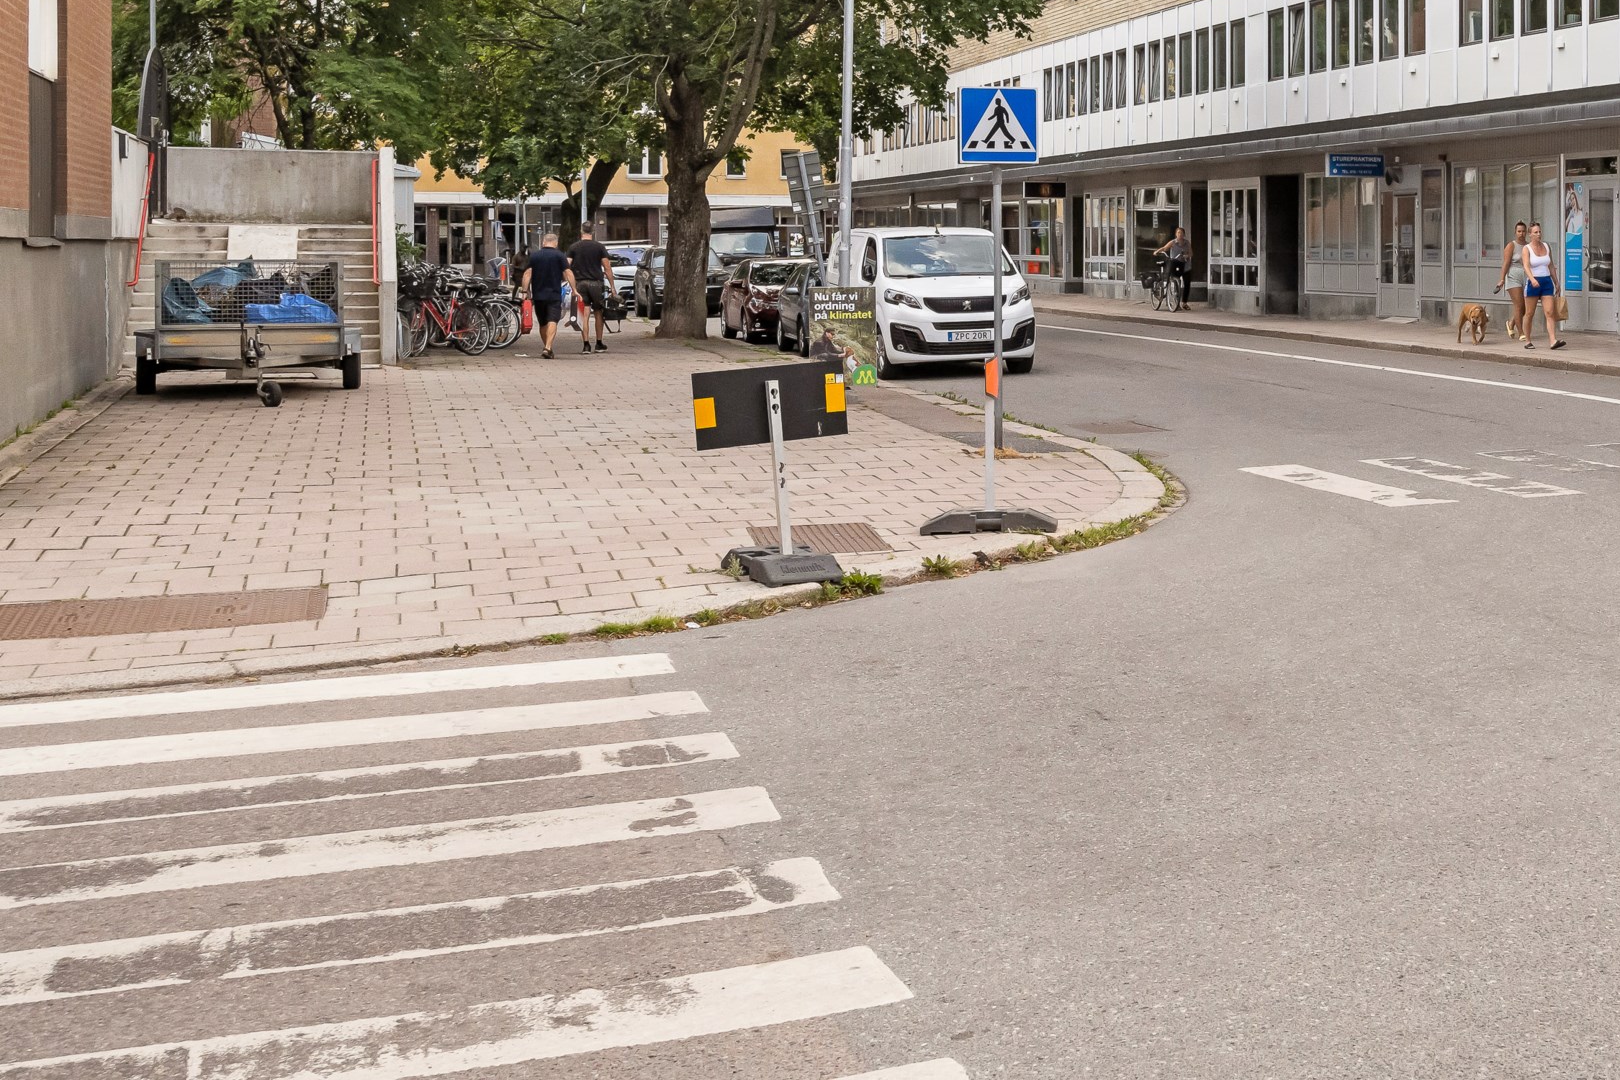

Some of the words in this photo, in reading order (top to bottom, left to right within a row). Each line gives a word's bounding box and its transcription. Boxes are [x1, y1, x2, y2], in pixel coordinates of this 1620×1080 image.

[814, 293, 829, 301] Nu
[831, 291, 847, 301] får
[849, 292, 858, 301] vi
[814, 302, 855, 311] ordning
[814, 310, 828, 321] på
[829, 310, 872, 319] klimatet
[955, 332, 970, 340] ZPC
